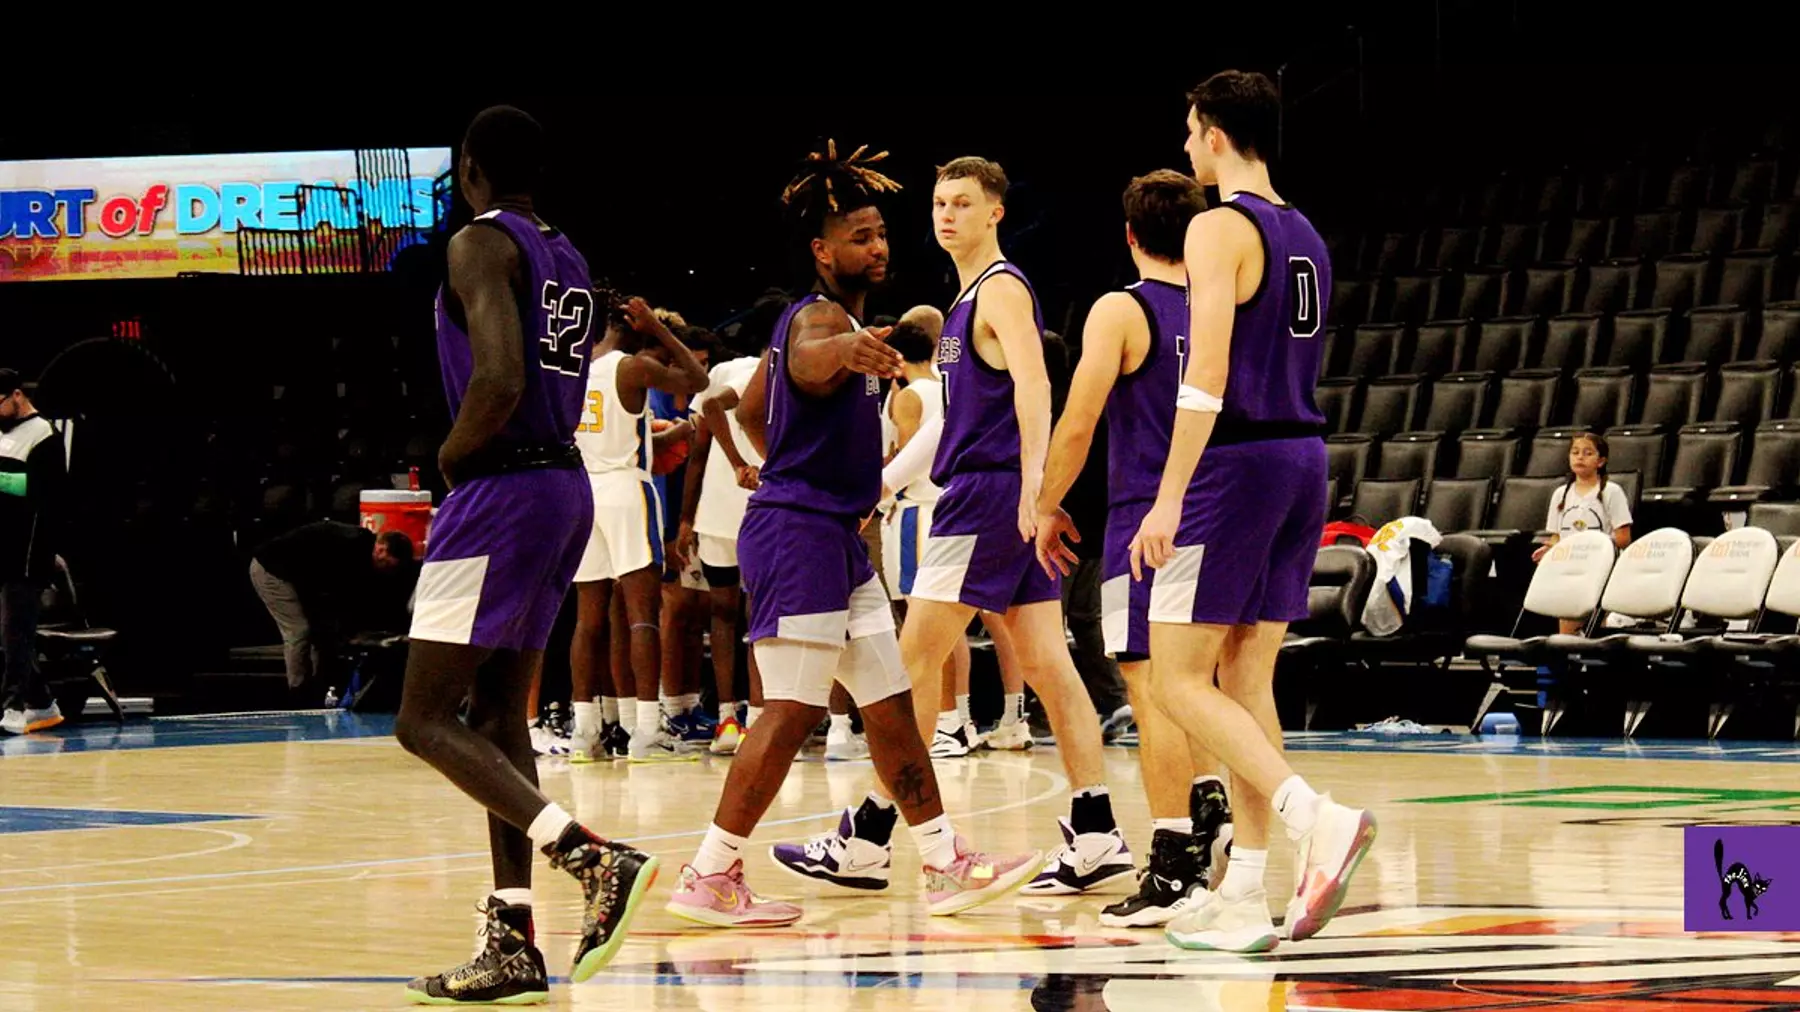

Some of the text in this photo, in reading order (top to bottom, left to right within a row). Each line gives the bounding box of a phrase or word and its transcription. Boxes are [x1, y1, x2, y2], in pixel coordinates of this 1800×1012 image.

[99, 183, 168, 237] of
[175, 176, 437, 235] DREAMS
[540, 279, 594, 377] 32
[576, 390, 605, 433] 3
